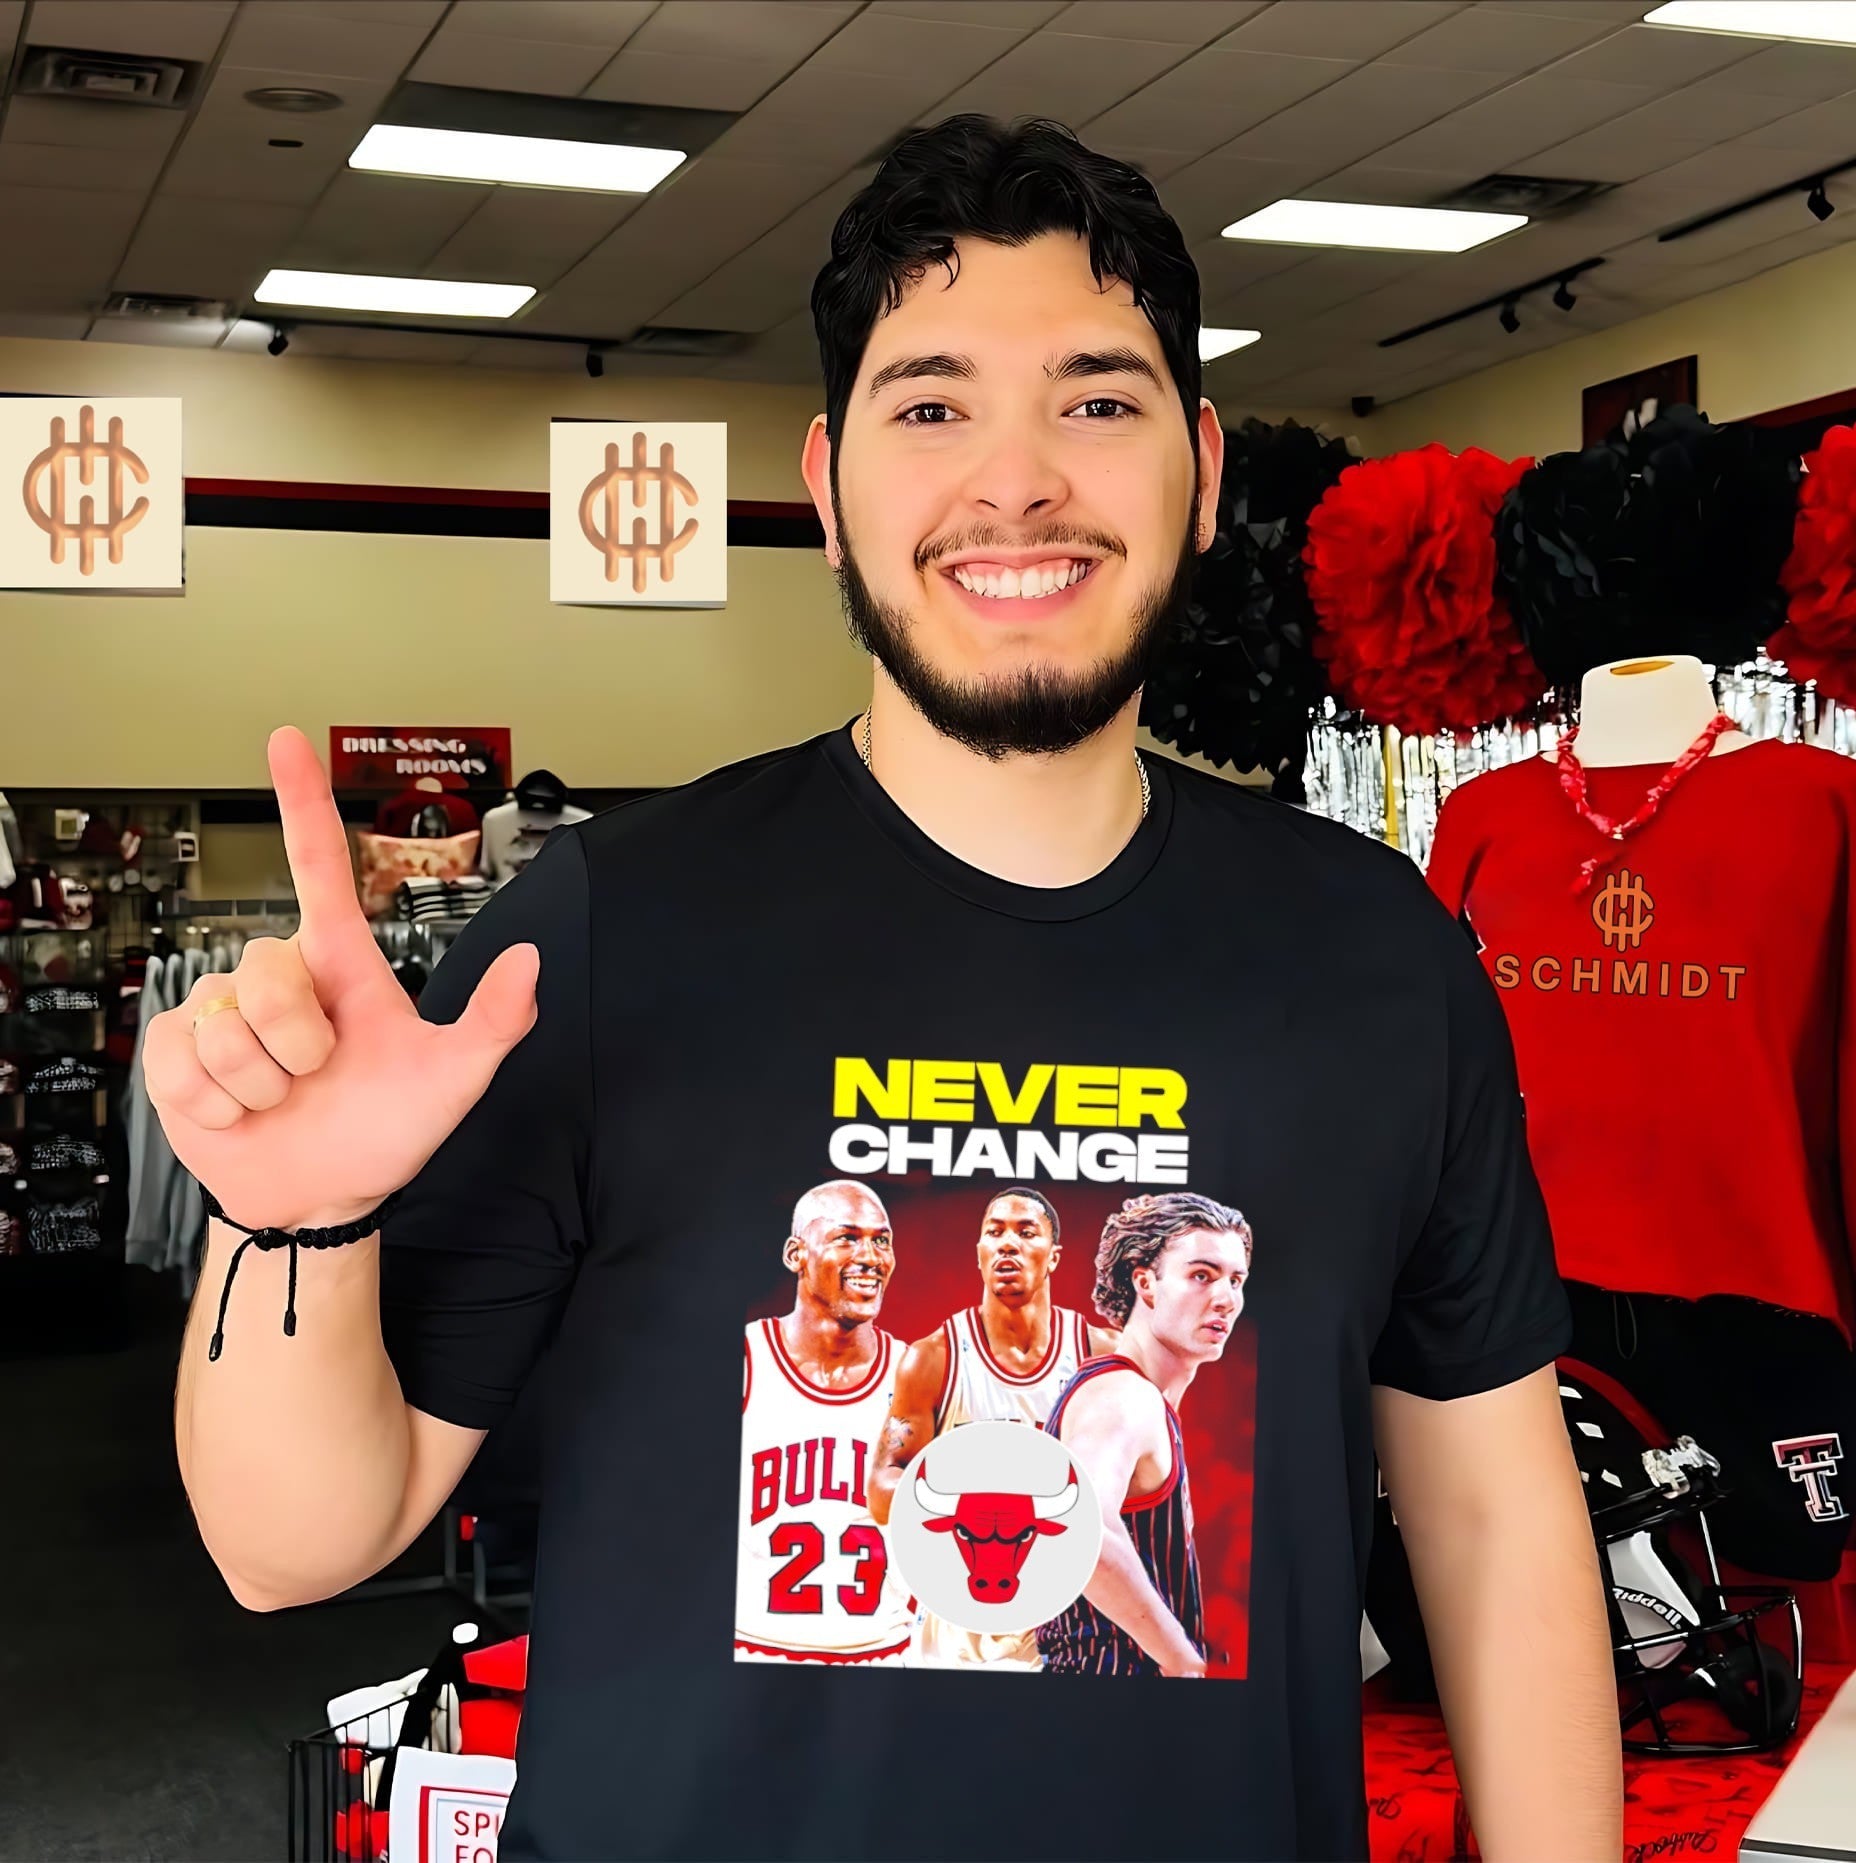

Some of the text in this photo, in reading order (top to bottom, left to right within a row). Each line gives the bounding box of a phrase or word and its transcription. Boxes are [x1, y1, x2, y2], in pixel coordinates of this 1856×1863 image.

[342, 737, 467, 754] DRESSING
[396, 758, 487, 775] ROOMS
[1494, 953, 1747, 1001] SCHMIDT
[833, 1057, 1188, 1129] NEVER
[828, 1125, 1189, 1185] CHANGE
[767, 1522, 888, 1615] 23
[454, 1809, 500, 1838] SPI
[455, 1844, 494, 1863] FO
